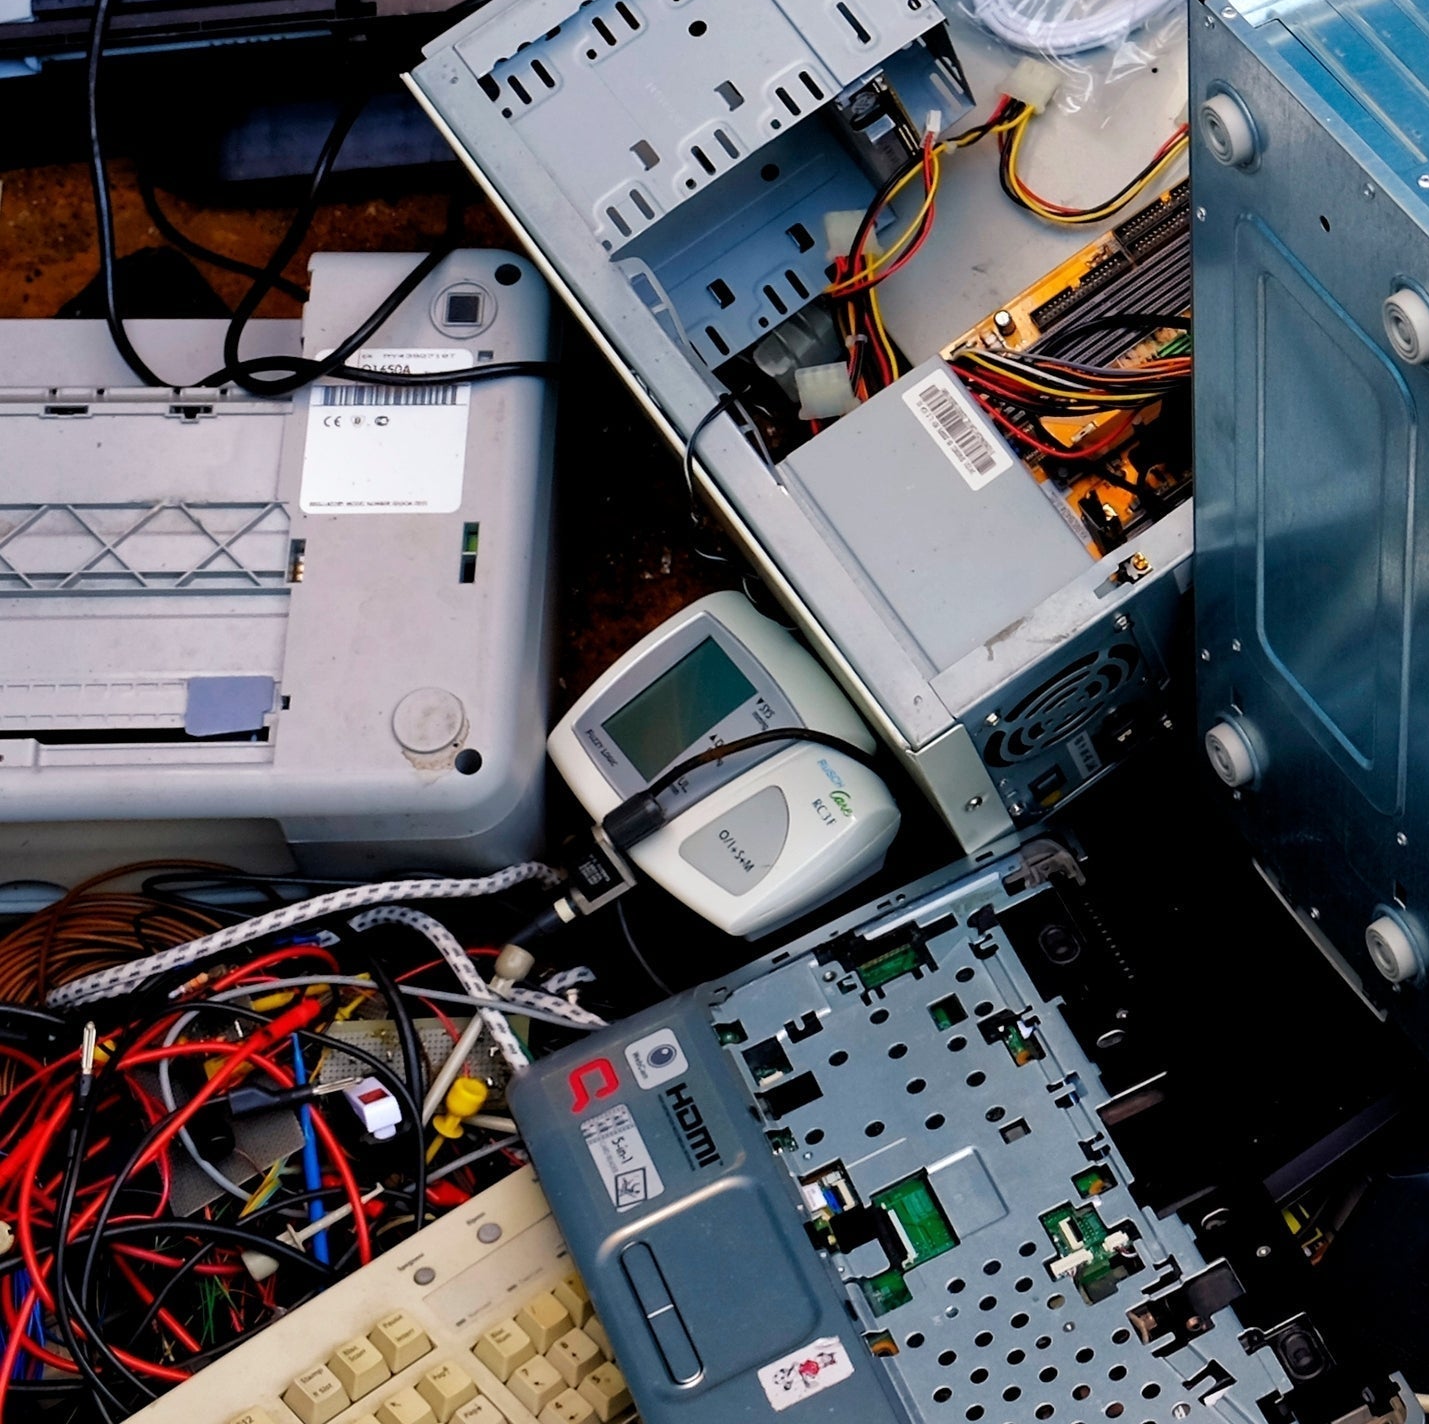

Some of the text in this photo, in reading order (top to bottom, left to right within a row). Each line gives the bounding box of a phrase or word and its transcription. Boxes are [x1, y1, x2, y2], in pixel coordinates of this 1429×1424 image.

[759, 701, 776, 719] SYS
[828, 789, 854, 818] Care
[665, 1082, 721, 1168] HDMI
